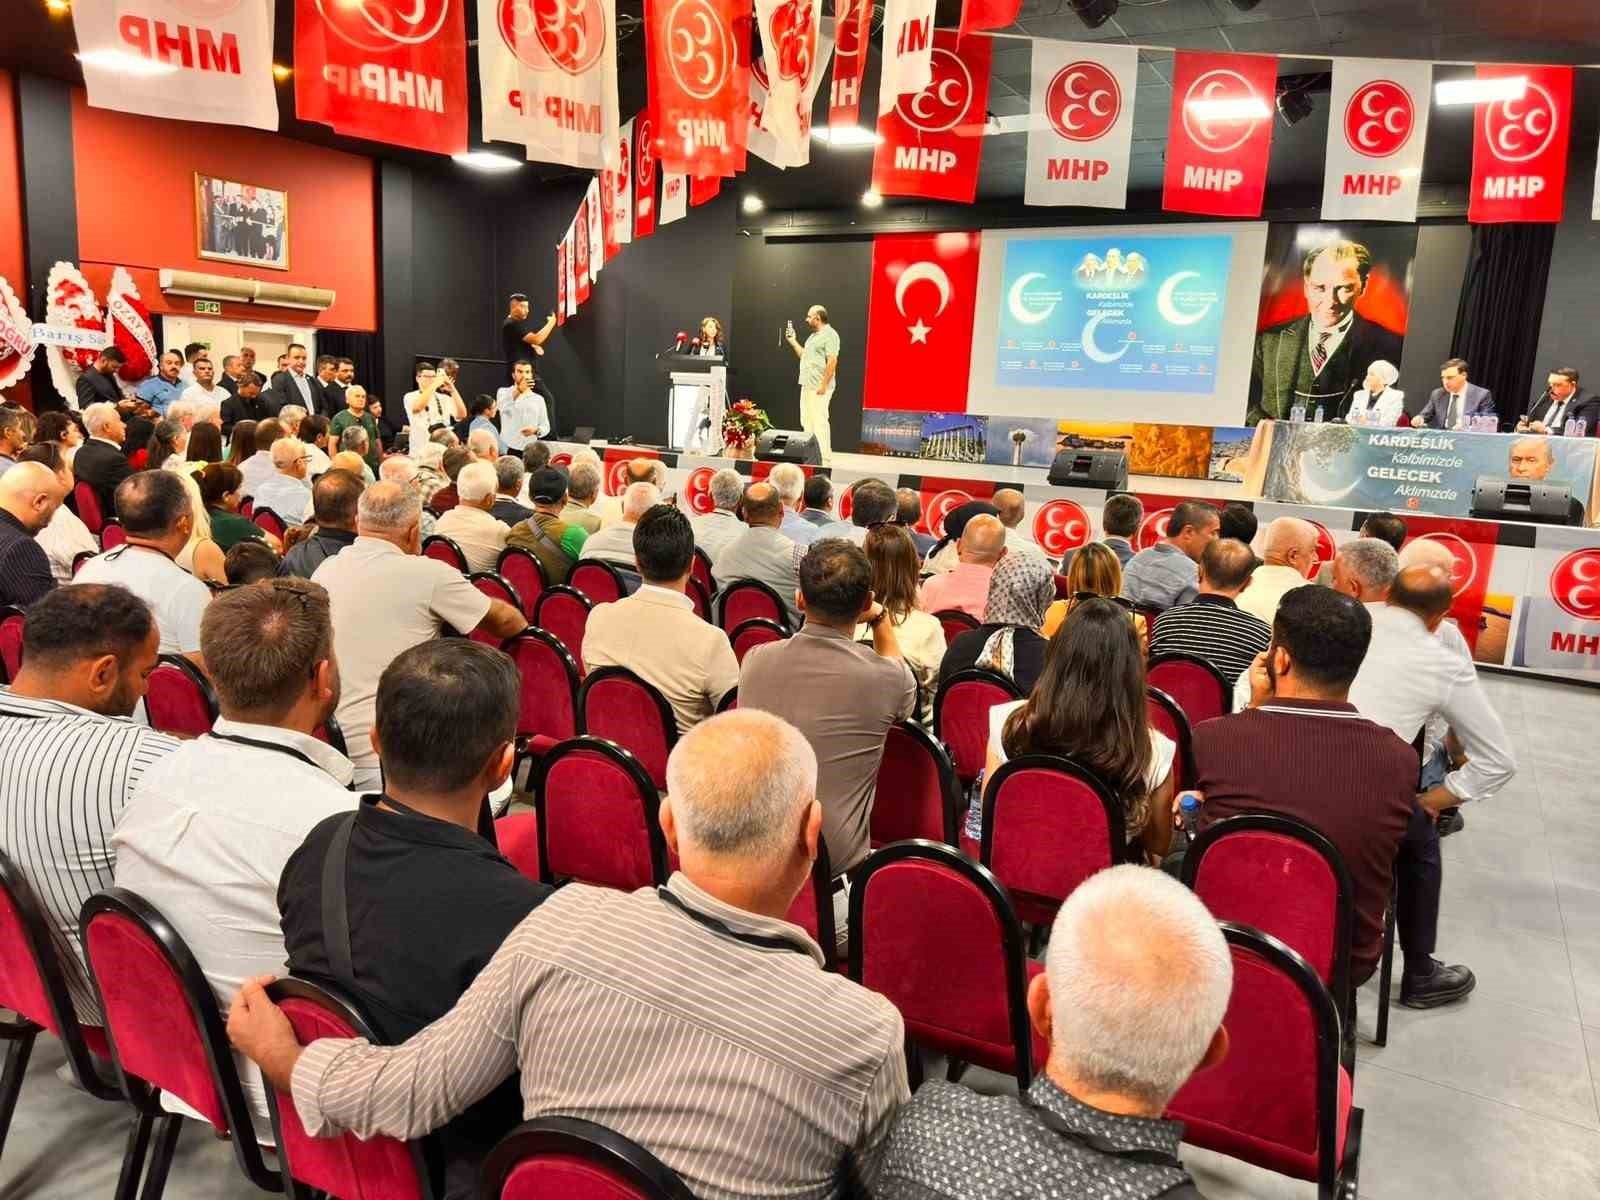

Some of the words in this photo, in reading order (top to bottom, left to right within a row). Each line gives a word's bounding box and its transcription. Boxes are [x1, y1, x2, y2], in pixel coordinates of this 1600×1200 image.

[894, 146, 957, 174] MHP
[1046, 158, 1111, 182] MHP
[1183, 165, 1245, 192] MHP
[1342, 174, 1402, 197] MHP
[1483, 175, 1546, 199] MHP
[1366, 465, 1443, 484] GELECEK
[1551, 631, 1600, 656] MH
